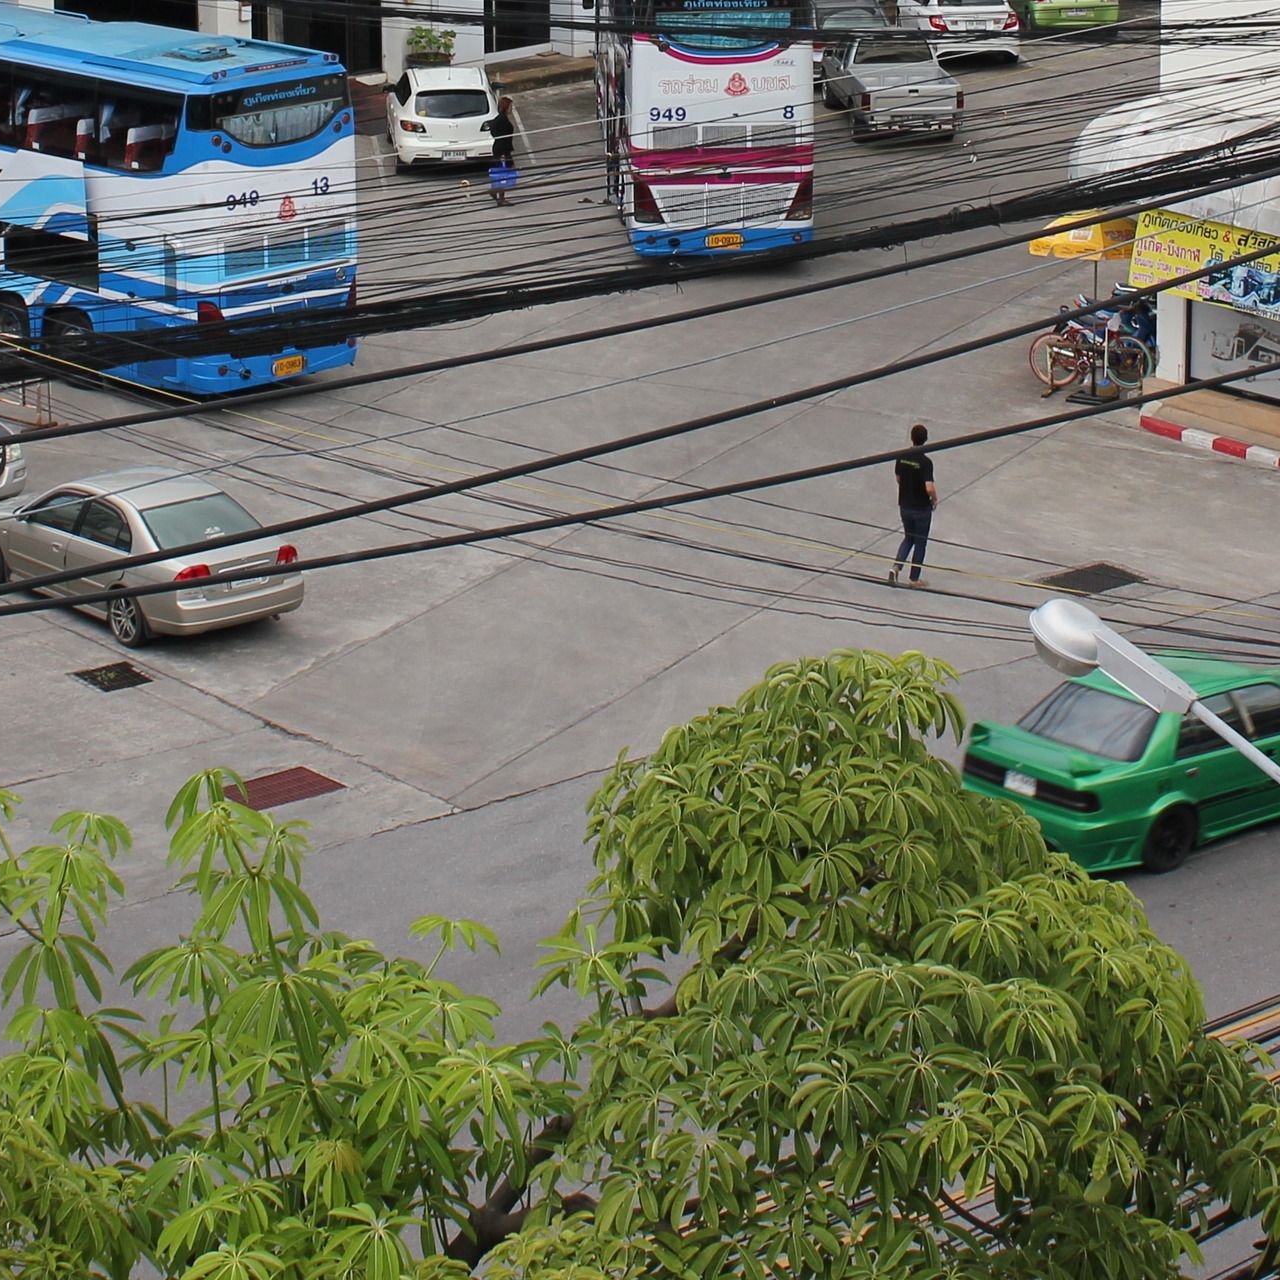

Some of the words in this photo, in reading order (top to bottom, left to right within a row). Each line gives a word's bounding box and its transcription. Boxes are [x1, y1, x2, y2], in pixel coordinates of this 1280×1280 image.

[658, 73, 719, 95] รถร่วม
[243, 84, 317, 107] ภูเก็ตท่องเที่ยว
[649, 107, 687, 121] 949
[783, 105, 795, 119] 8
[312, 176, 330, 195] 13
[1222, 230, 1232, 243] &
